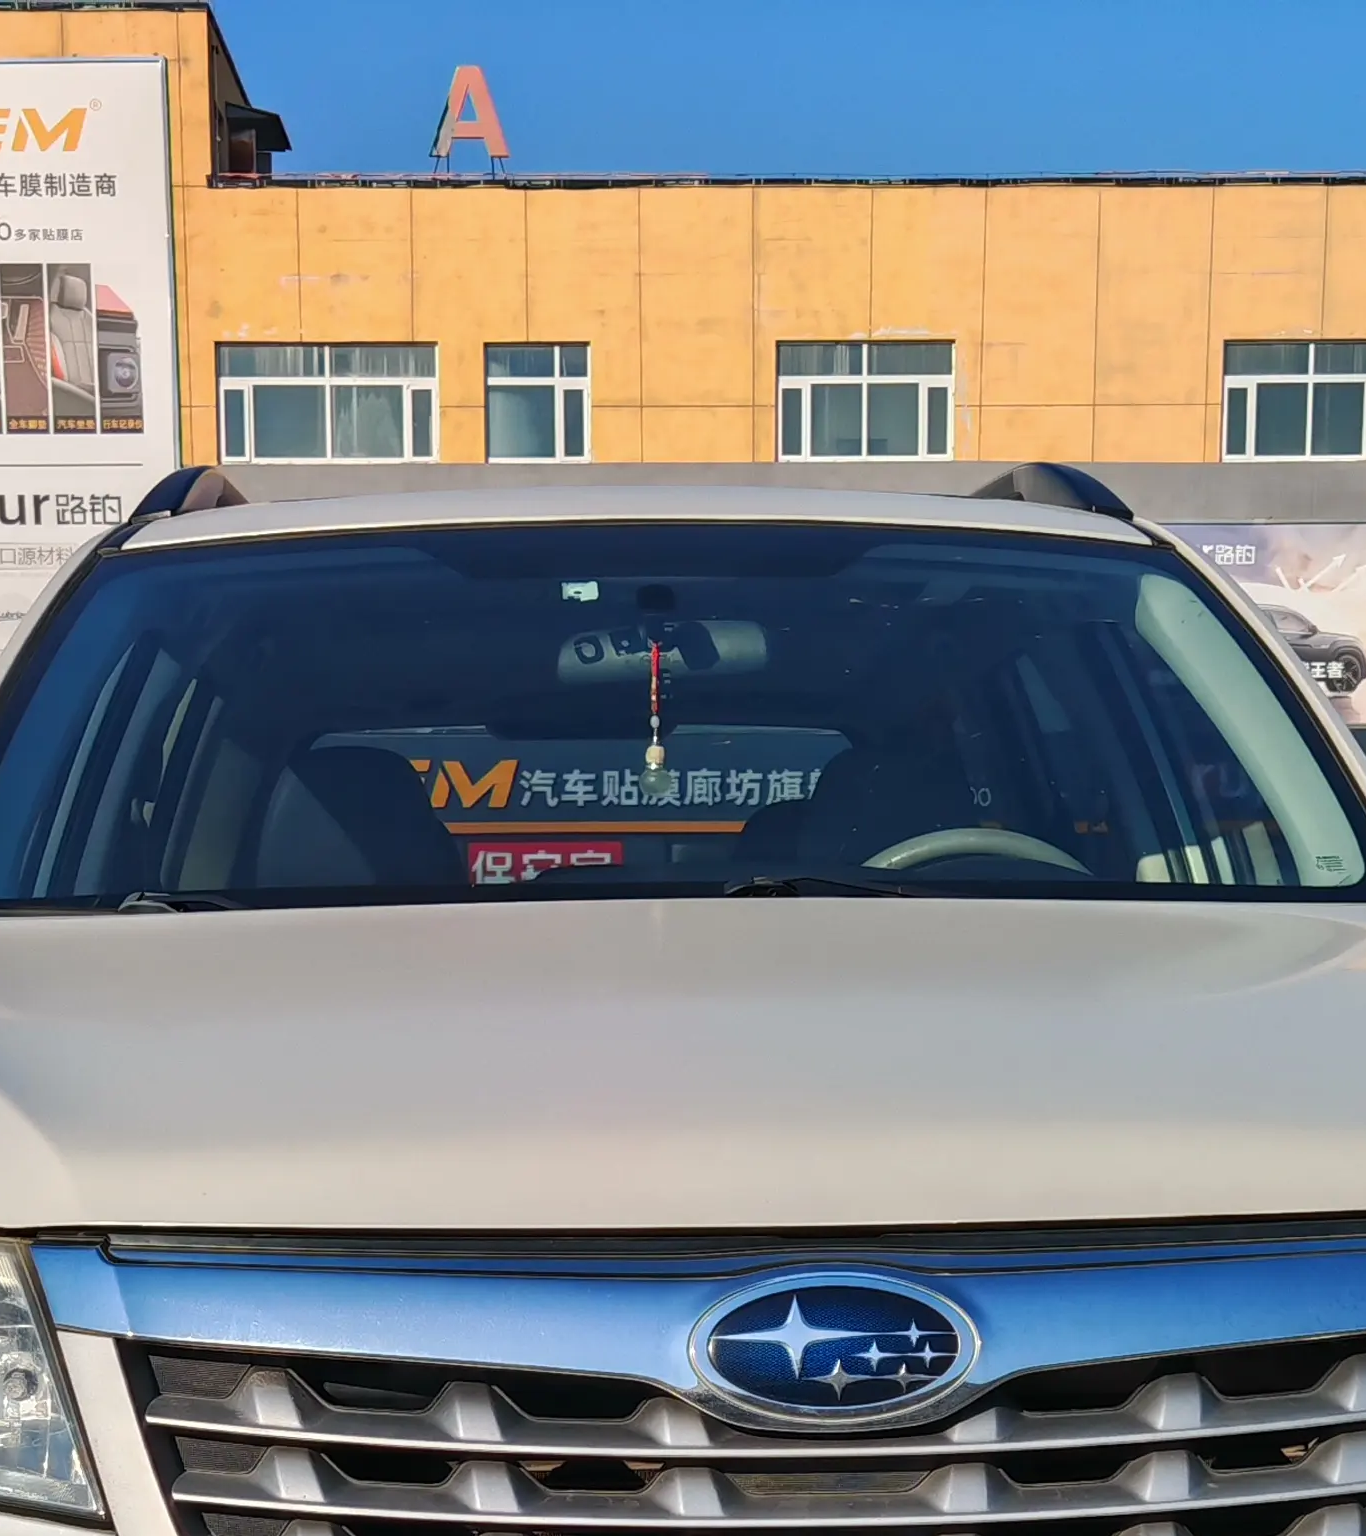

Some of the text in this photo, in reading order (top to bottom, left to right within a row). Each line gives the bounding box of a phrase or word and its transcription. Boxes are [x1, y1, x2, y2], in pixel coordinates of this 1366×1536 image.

[431, 65, 509, 158] A
[1304, 661, 1345, 679] 王者
[519, 768, 821, 807] 汽车贴膜廊坊旗
